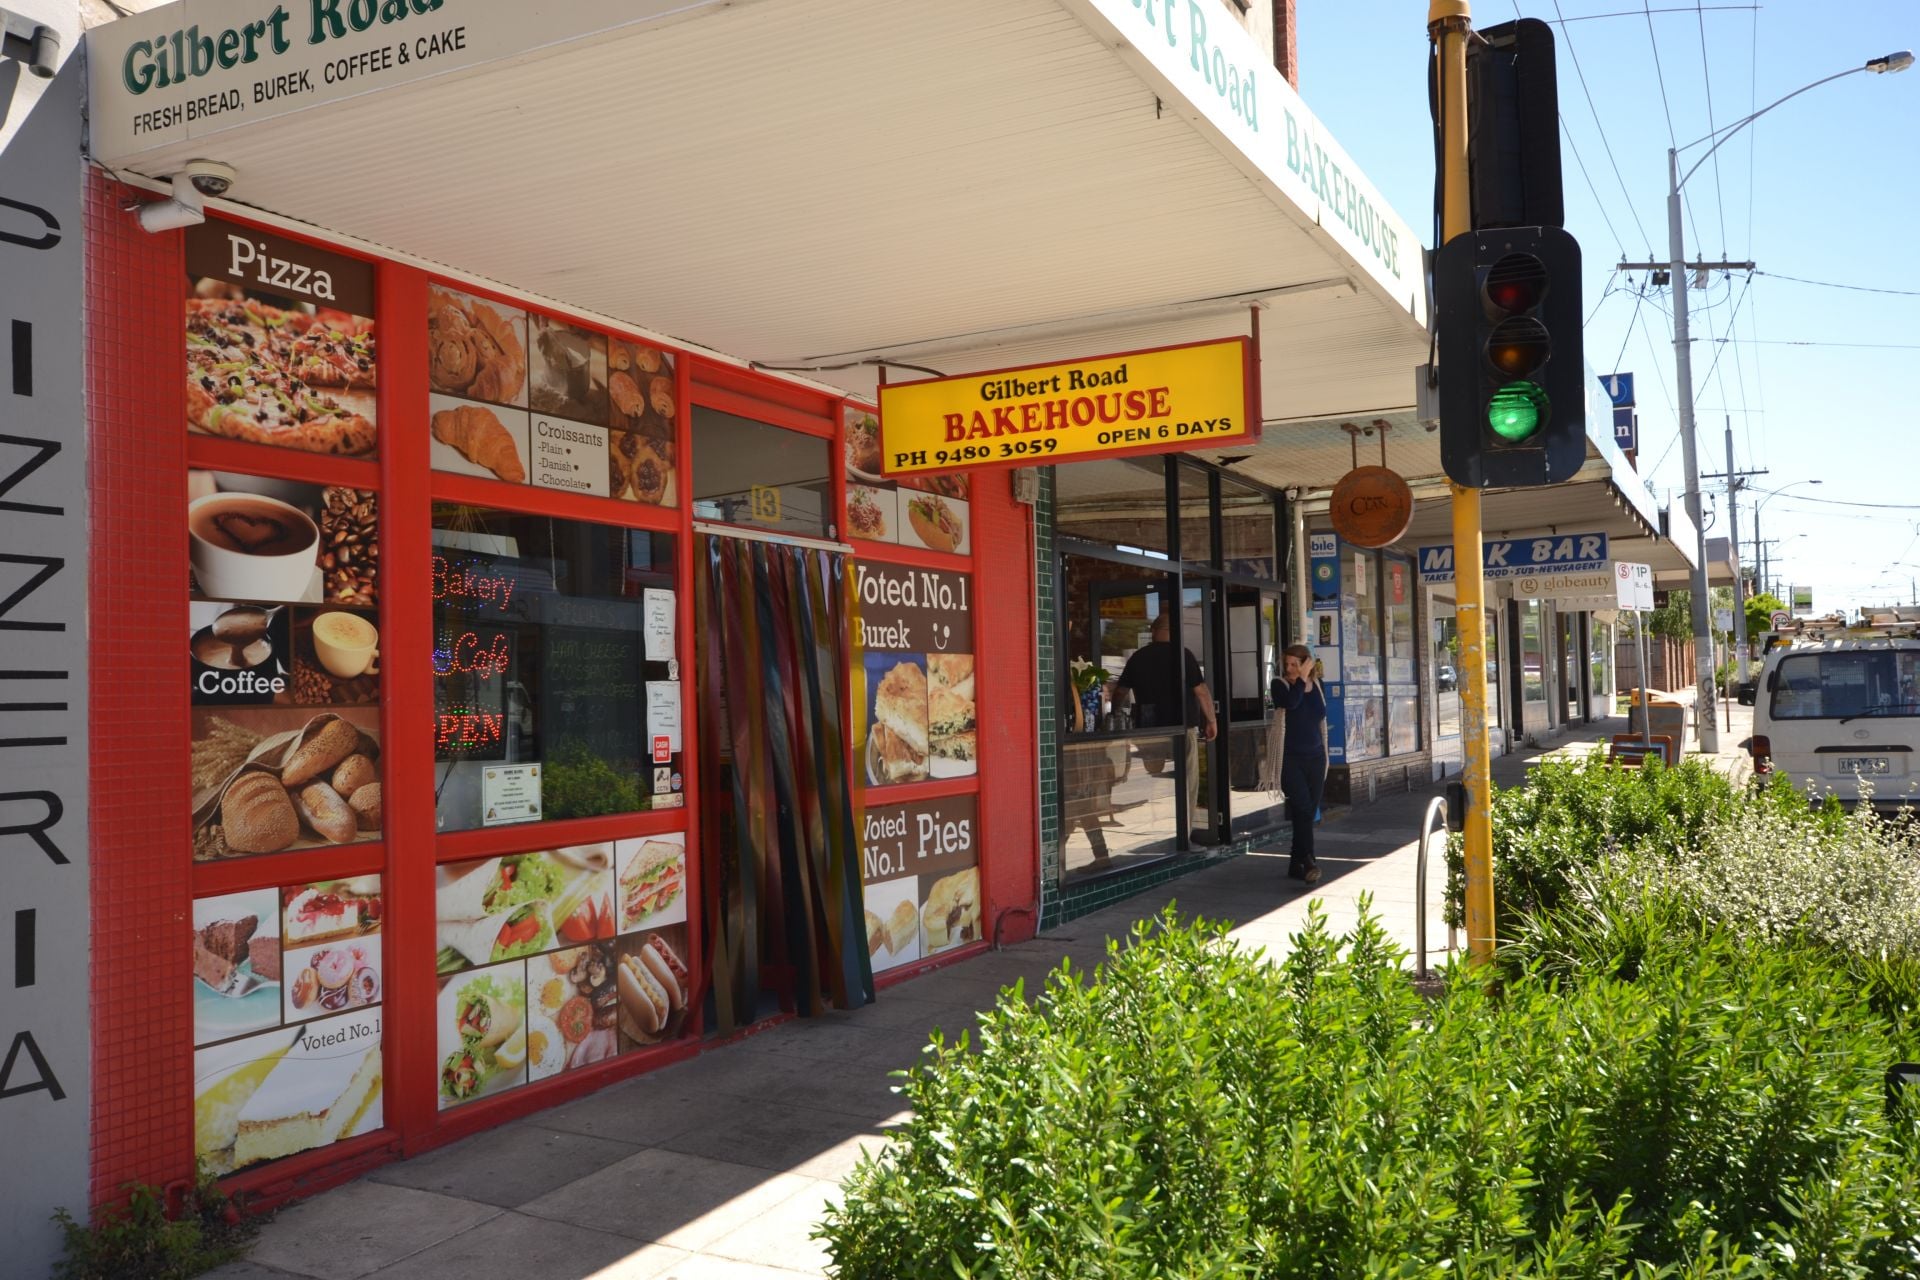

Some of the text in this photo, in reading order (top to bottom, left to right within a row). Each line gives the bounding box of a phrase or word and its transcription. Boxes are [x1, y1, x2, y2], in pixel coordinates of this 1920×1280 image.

[122, 0, 444, 95] Gilbert Road
[134, 26, 466, 135] FRESH BREAD, BUREK, COFFEE & CAKE
[1188, 0, 1258, 132] Road
[1284, 106, 1401, 280] BAKEHOUSE
[227, 234, 335, 301] Pizza
[980, 364, 1128, 402] Gilbert Road
[944, 386, 1172, 443] BAKEHOUSE
[1097, 417, 1232, 445] OPEN 6 DAYS
[537, 421, 603, 448] Croissants
[895, 438, 1057, 467] PH 9480 3059
[1424, 536, 1602, 570] MK BAR
[431, 556, 516, 610] Bakery
[847, 565, 968, 611] Voted No.1
[1424, 573, 1448, 582] TAKE
[1544, 576, 1611, 592] globeauty
[1636, 566, 1647, 578] 1P
[853, 616, 910, 648] Burek
[199, 670, 286, 695] Coffee
[432, 714, 503, 743] PEN
[863, 810, 907, 841] Voted
[864, 811, 971, 879] No.1 Pies
[301, 1018, 381, 1051] Voted No.1
